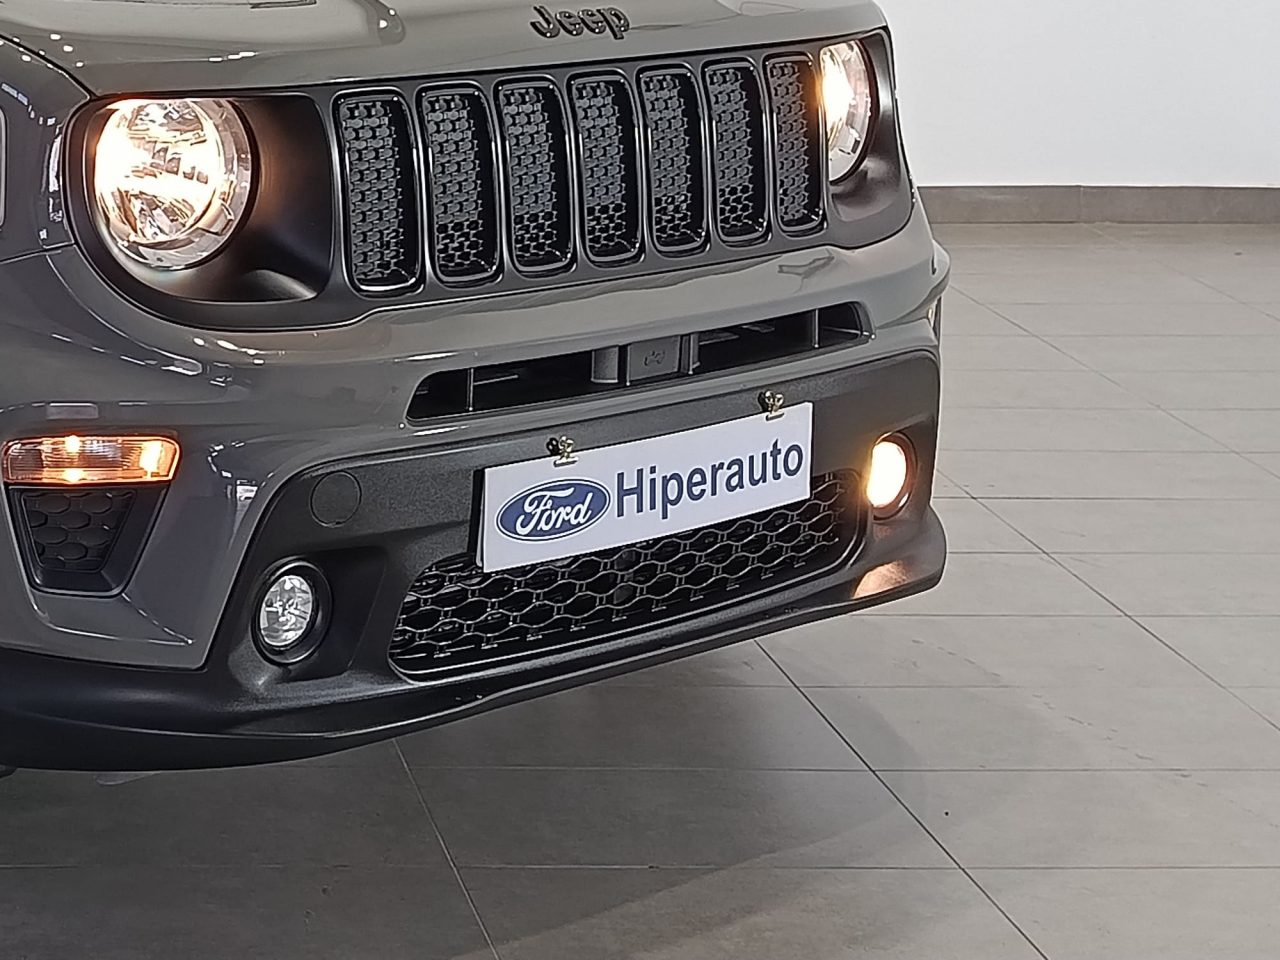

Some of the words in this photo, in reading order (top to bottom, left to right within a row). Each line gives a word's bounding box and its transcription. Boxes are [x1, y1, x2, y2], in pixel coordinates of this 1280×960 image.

[530, 5, 630, 40] Jeep
[515, 486, 594, 536] Ford
[616, 438, 804, 520] Hiperauto
